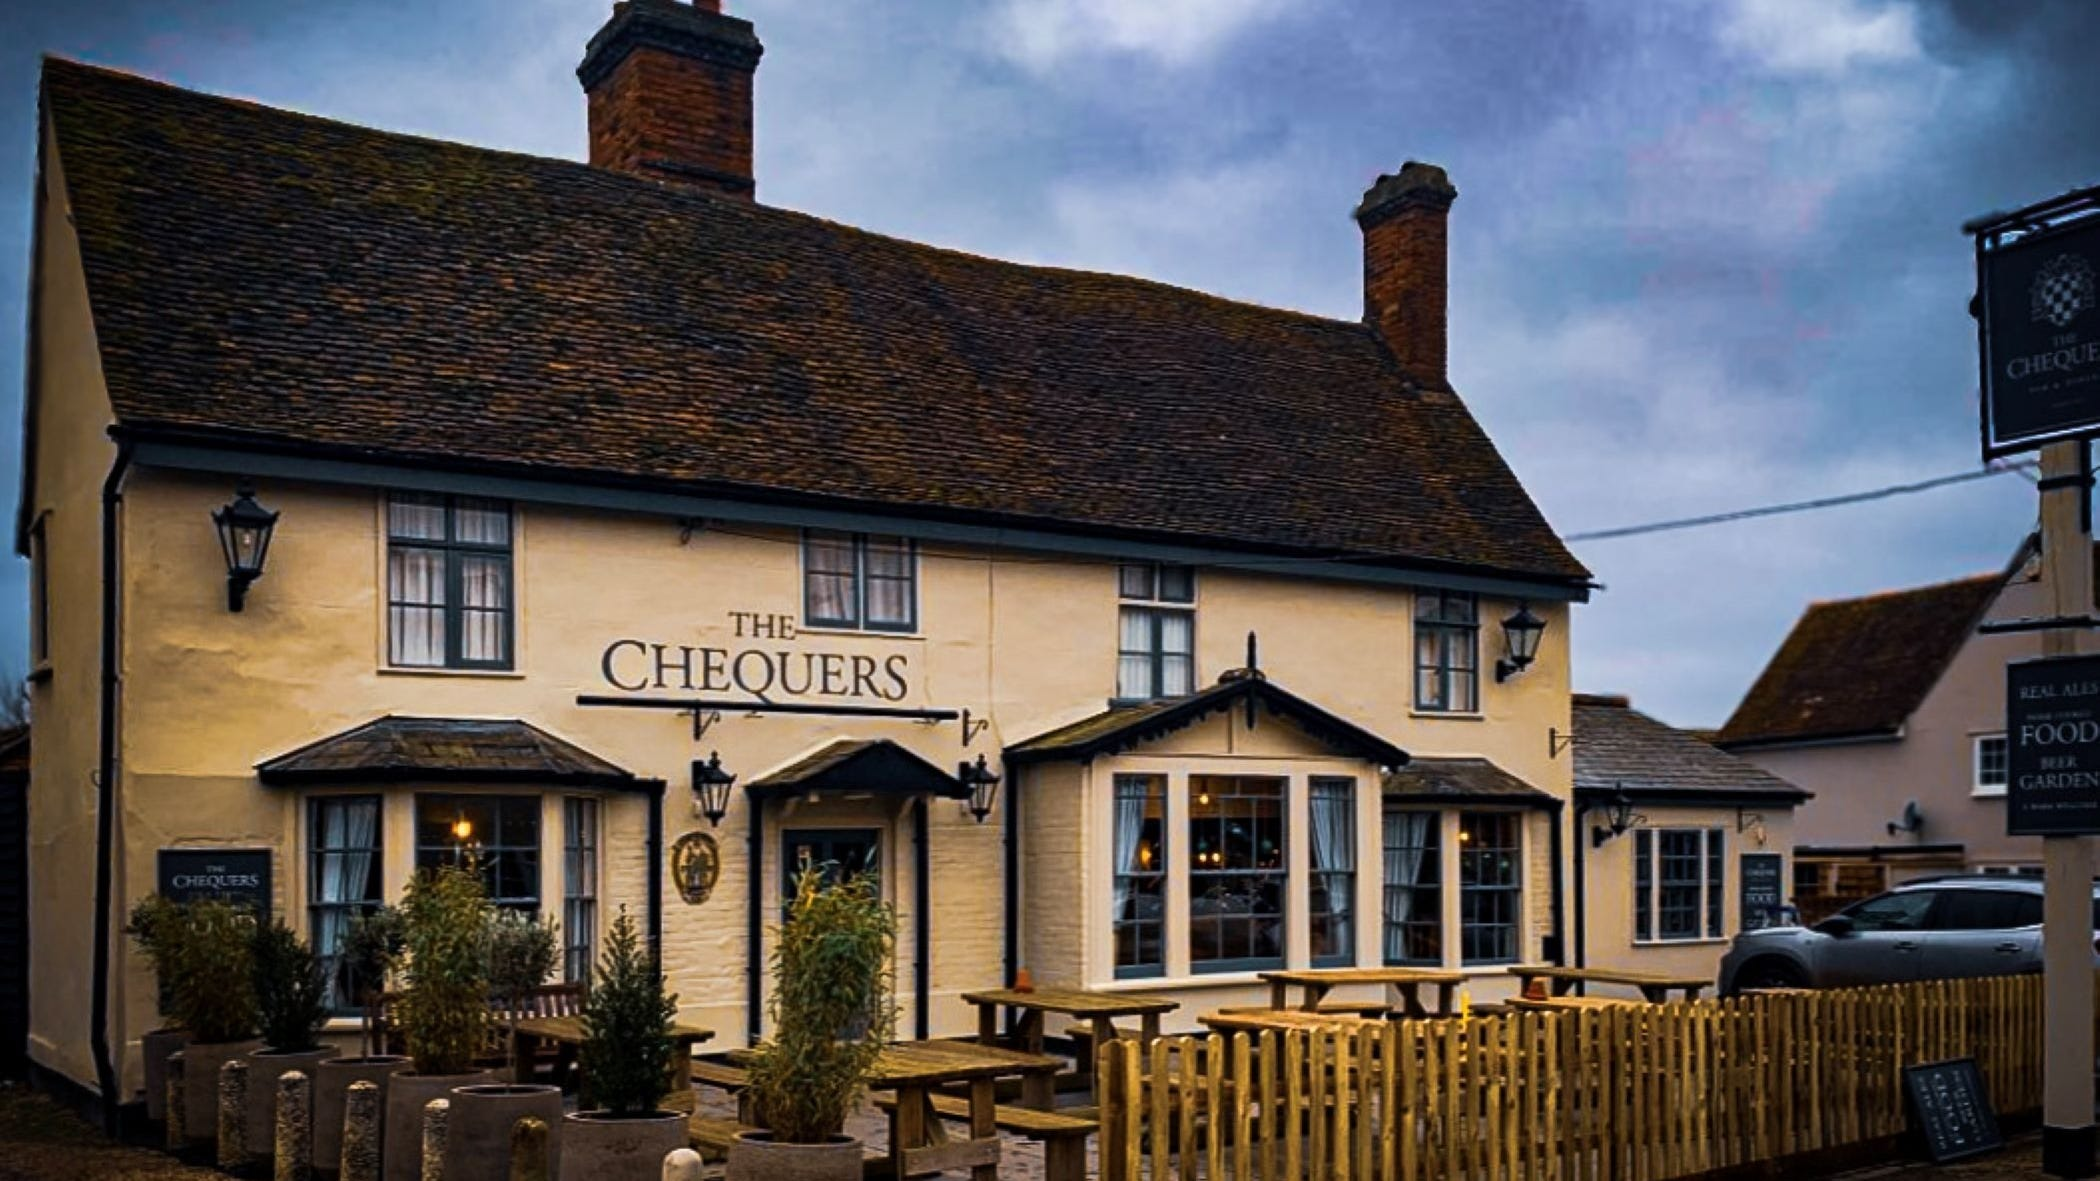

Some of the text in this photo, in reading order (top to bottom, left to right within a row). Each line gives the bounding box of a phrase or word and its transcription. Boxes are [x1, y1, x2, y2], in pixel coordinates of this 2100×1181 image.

[728, 611, 797, 641] THE
[601, 639, 909, 704] CHEQUERS
[2020, 682, 2098, 699] REAL ALES
[2020, 720, 2099, 746] FOOD
[2040, 755, 2078, 770] BEER
[2019, 772, 2099, 790] GARDEN
[172, 874, 259, 889] CHEQUERS
